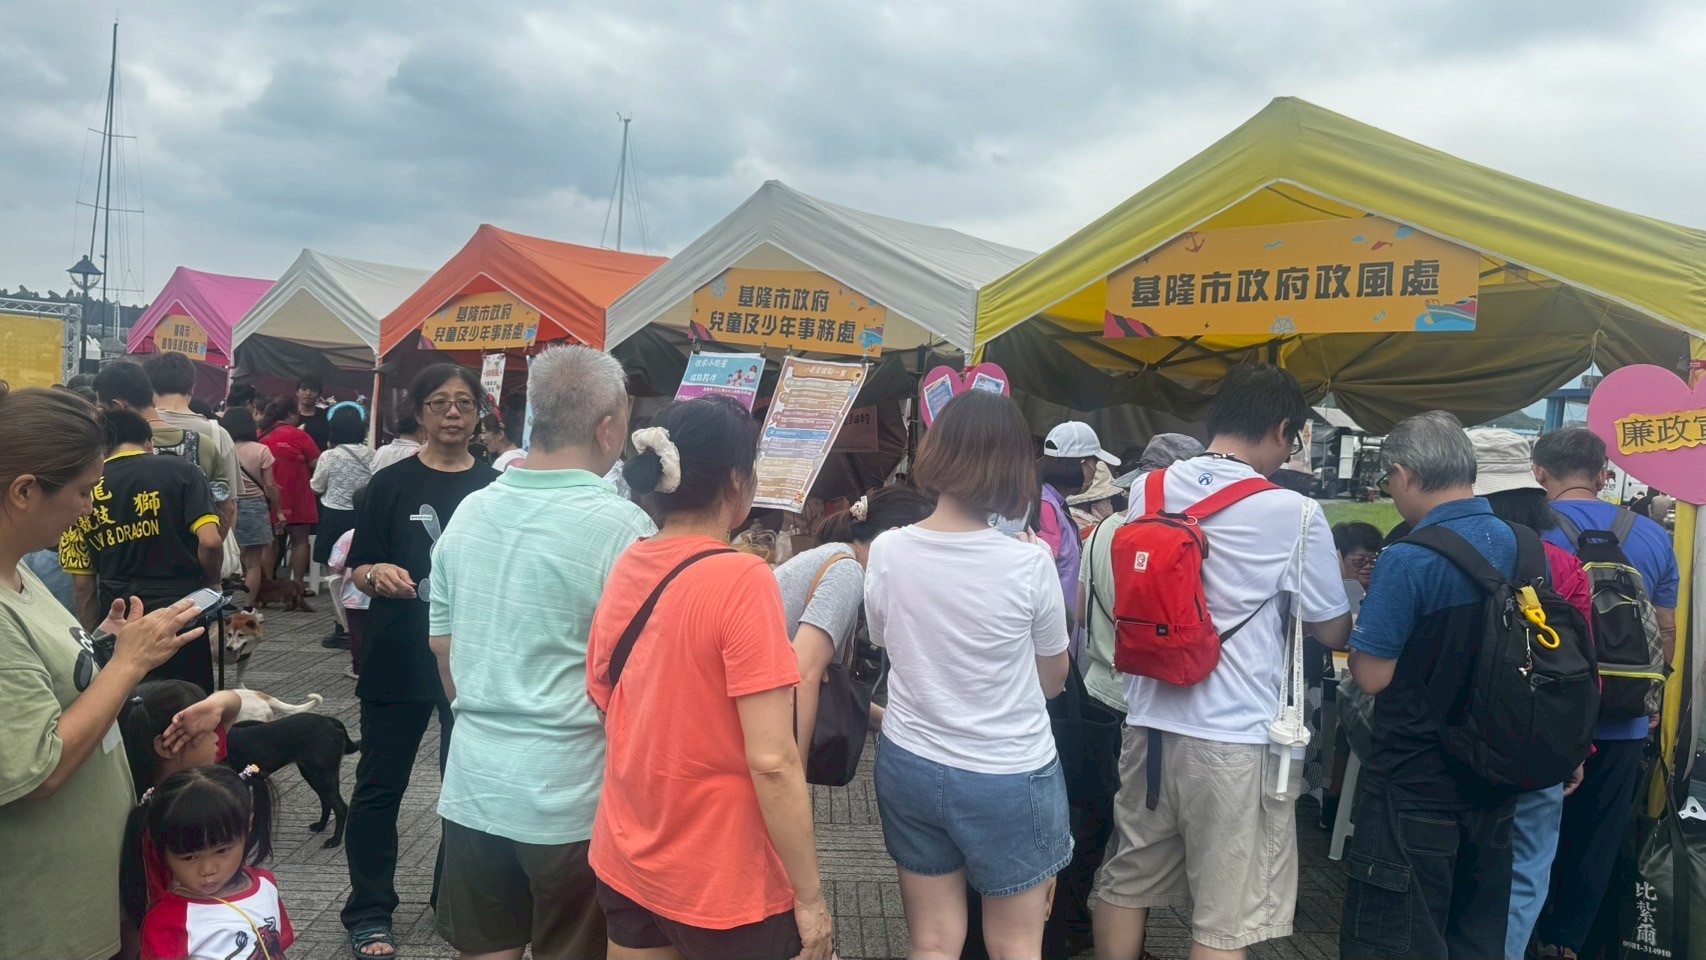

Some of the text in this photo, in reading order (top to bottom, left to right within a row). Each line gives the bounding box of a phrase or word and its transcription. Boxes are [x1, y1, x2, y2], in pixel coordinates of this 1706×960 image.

[1131, 259, 1440, 308] 基隆市政府政風處
[456, 303, 513, 322] 基隆市政府
[738, 285, 829, 313] 基隆市政府
[434, 323, 525, 342] 兒童及少年事務處
[709, 310, 857, 344] 兒童及少年事務處
[133, 490, 160, 517] 獅
[106, 529, 116, 546] &
[116, 518, 160, 544] DRAGON
